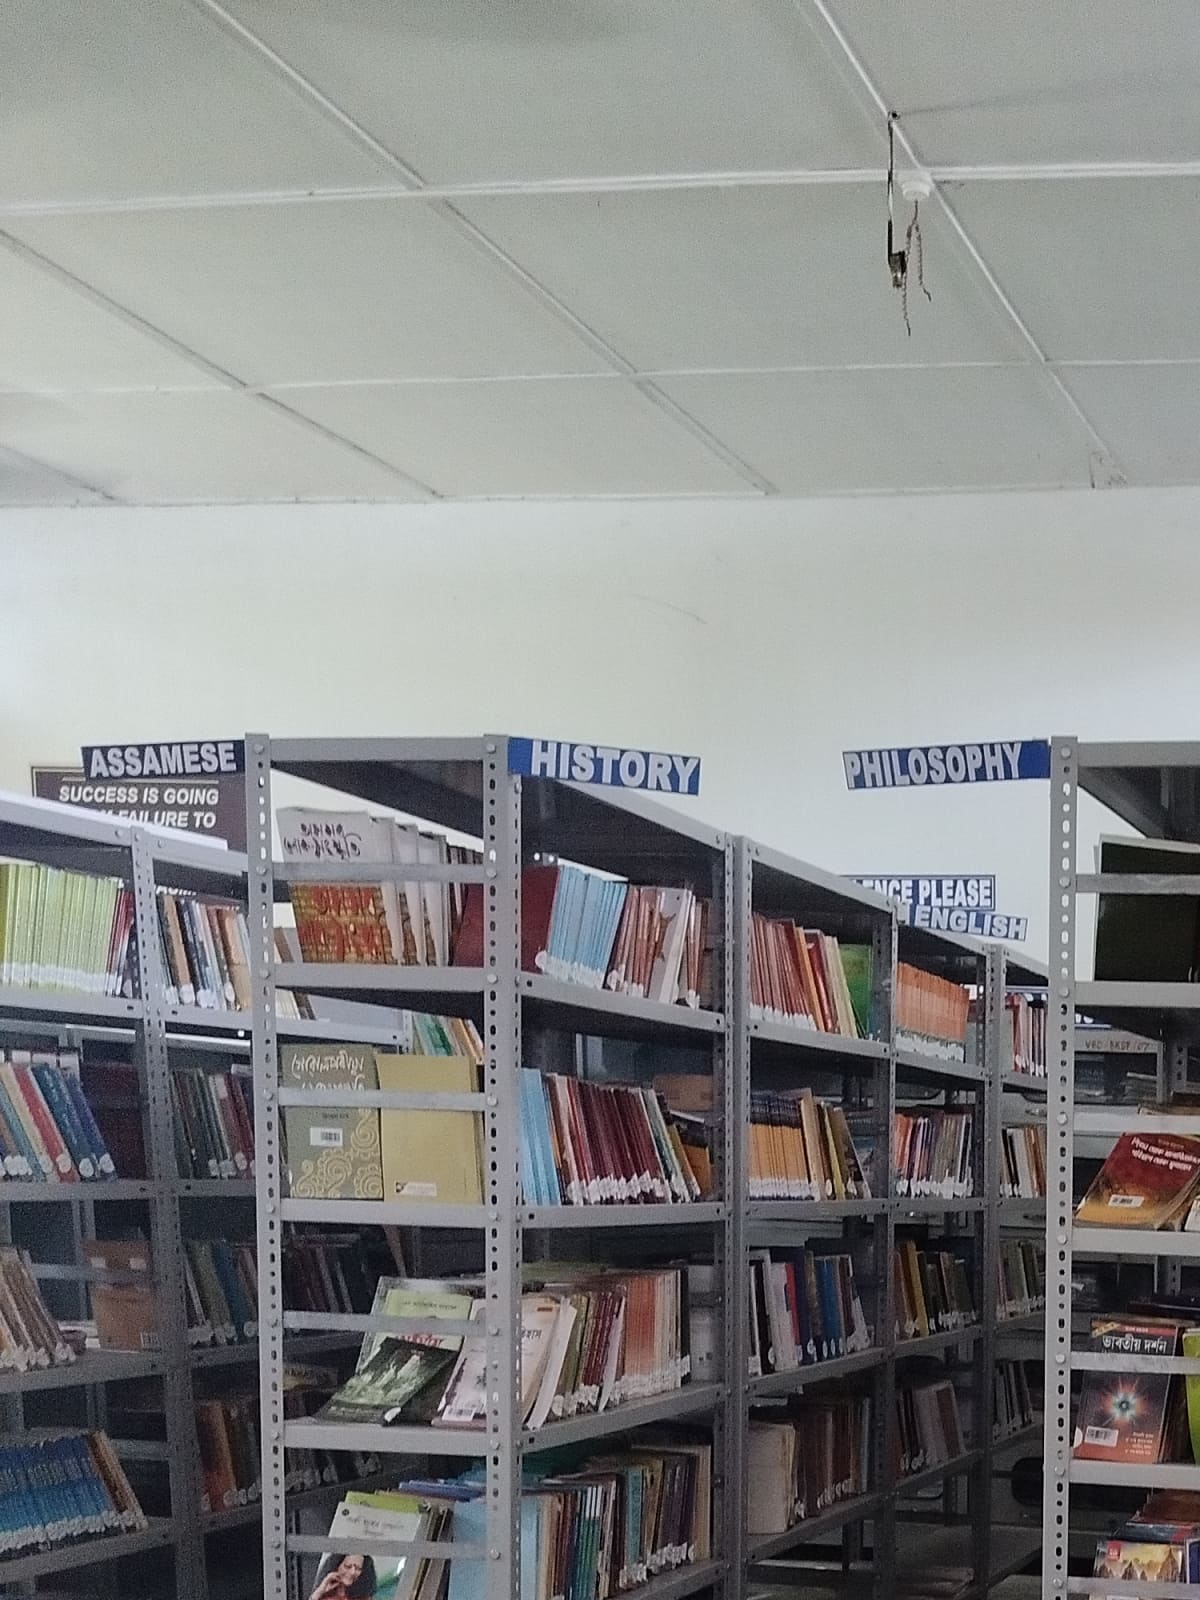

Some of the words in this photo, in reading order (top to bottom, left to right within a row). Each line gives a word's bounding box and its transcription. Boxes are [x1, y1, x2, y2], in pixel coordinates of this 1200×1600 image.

[89, 742, 237, 778] ASSAMESE
[531, 740, 700, 794] HISTORY
[843, 743, 1022, 788] PHILOSOPHY
[59, 785, 139, 803] SUCCESS
[142, 787, 159, 804] IS
[164, 788, 219, 805] GOING
[193, 810, 217, 828] TO
[918, 879, 992, 908] PLEASE
[914, 904, 1025, 940] ENGLISH
